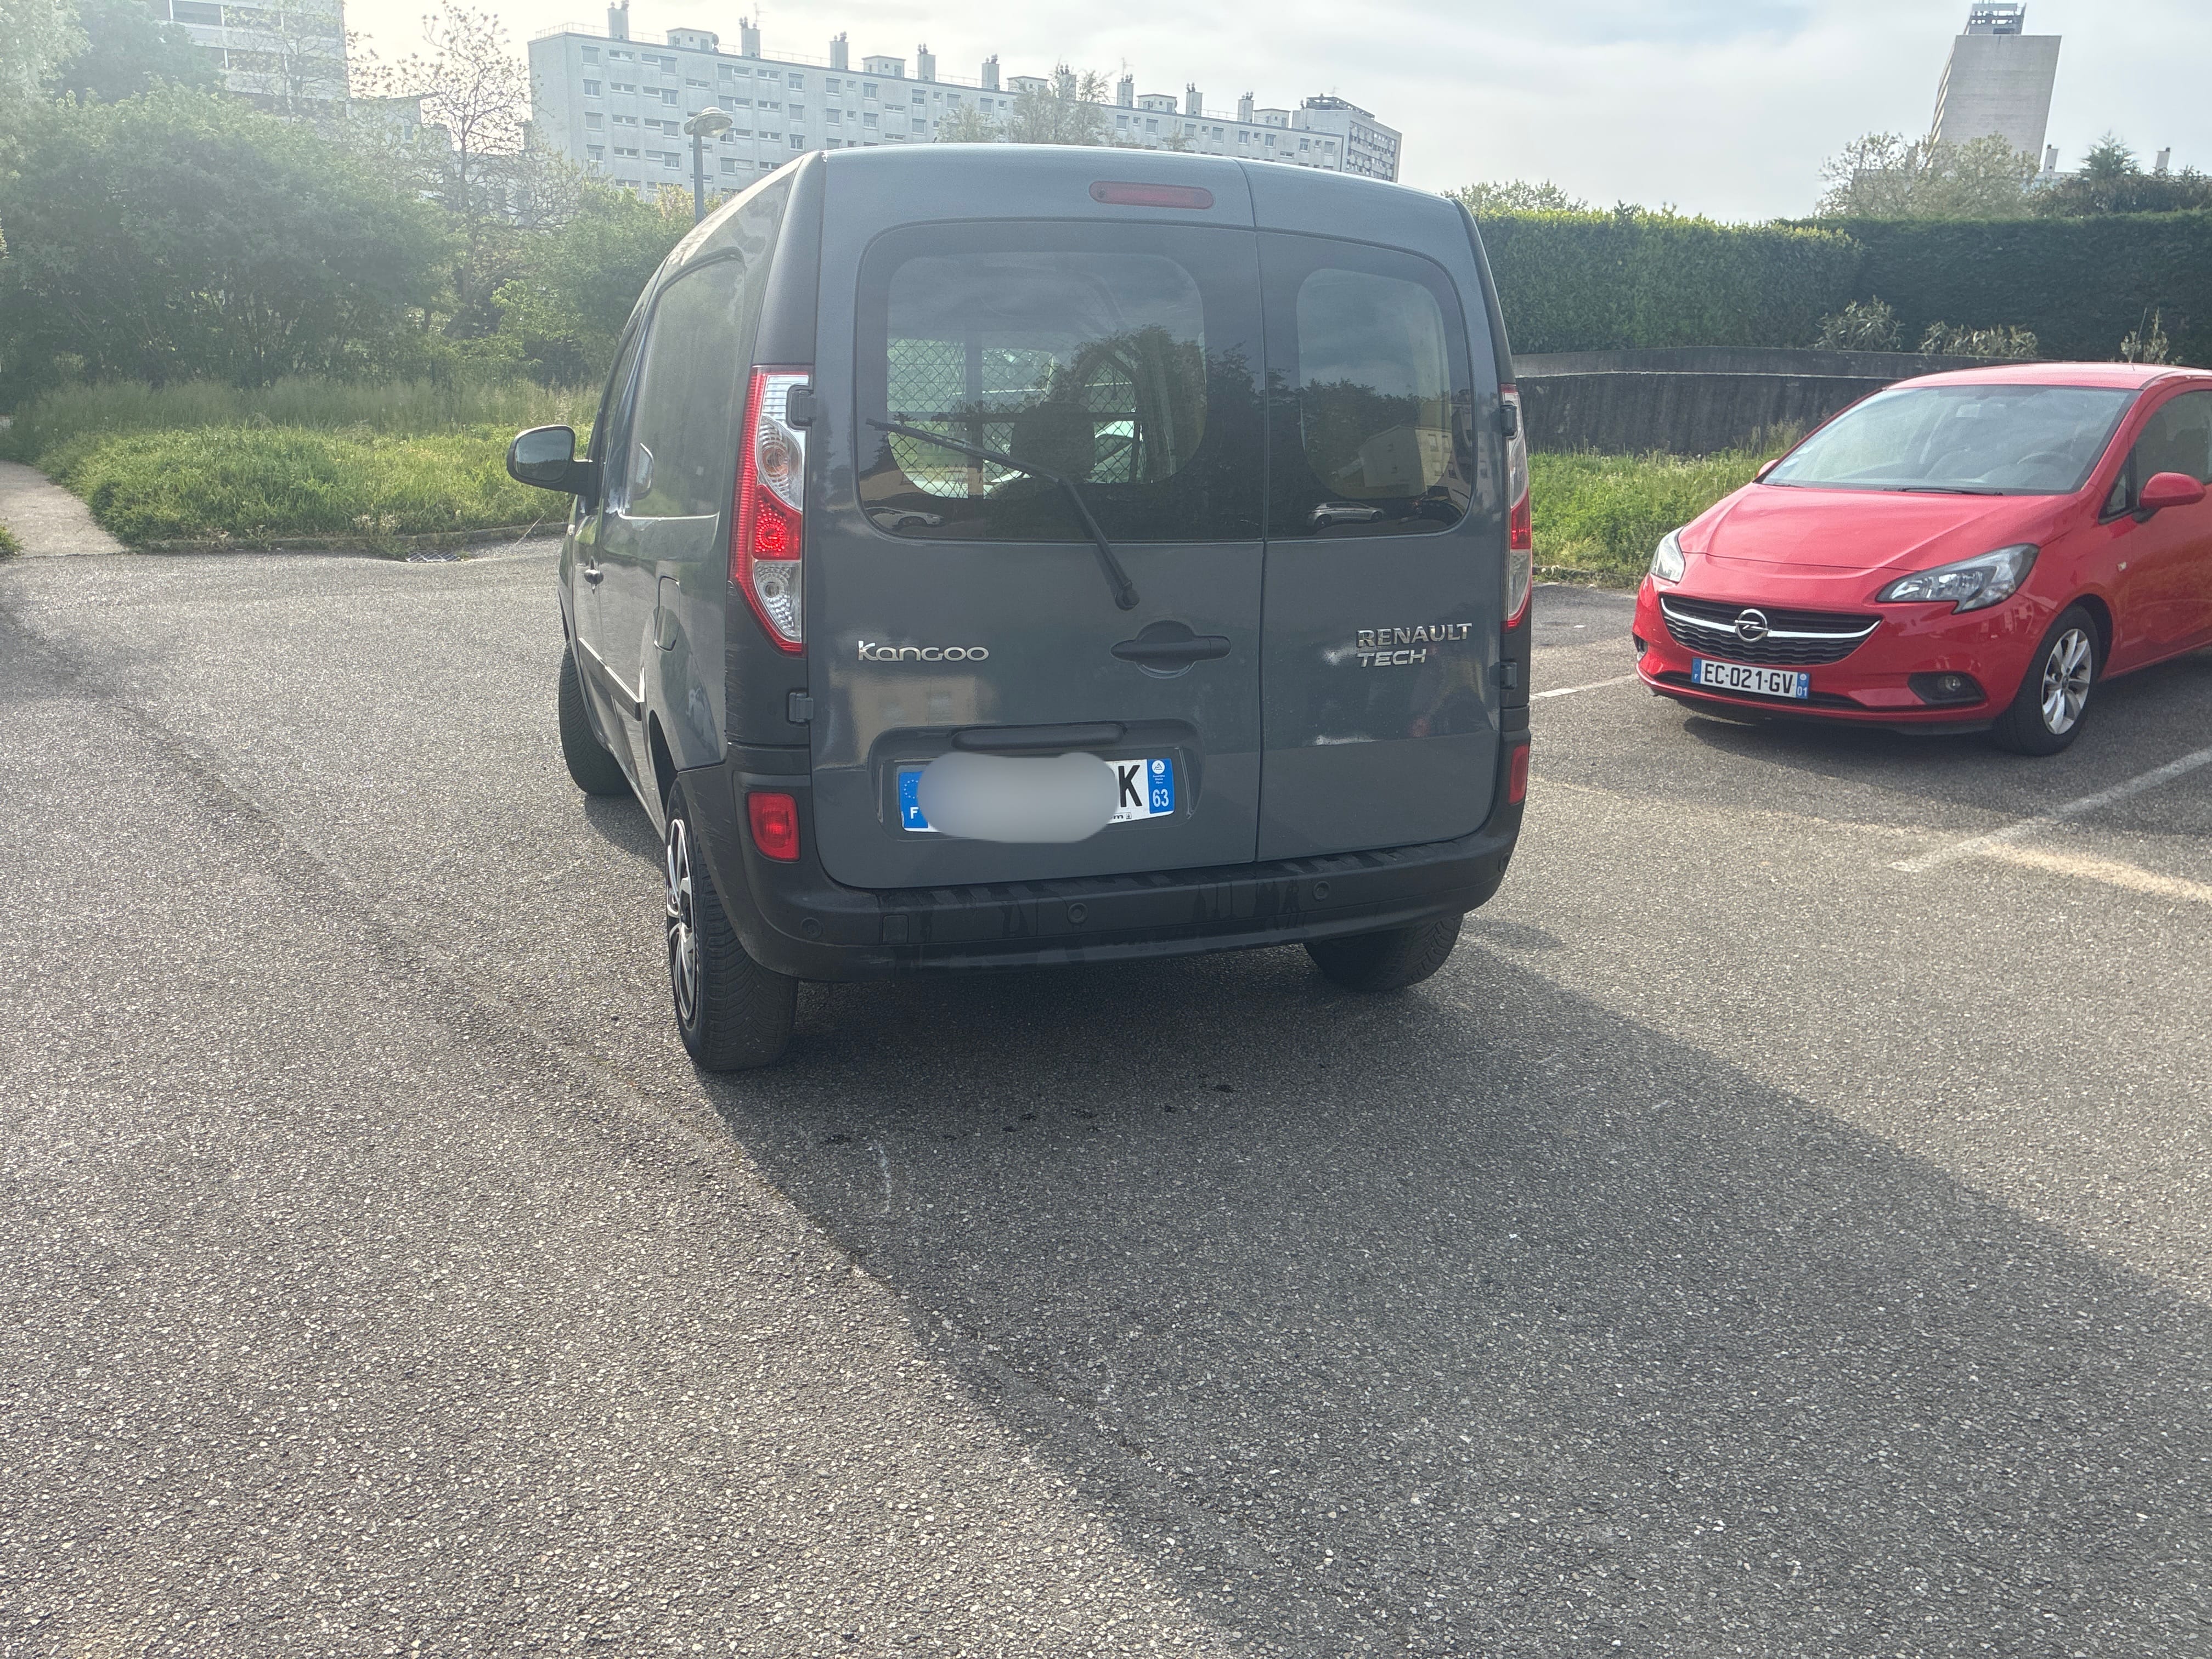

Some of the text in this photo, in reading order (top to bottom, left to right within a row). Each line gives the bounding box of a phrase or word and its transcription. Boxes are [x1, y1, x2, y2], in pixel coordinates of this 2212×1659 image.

[1356, 622, 1472, 647] RENAULT
[857, 640, 989, 662] Kangoo
[1356, 648, 1427, 668] TECH
[1704, 663, 1793, 694] EC-021-GV
[1797, 686, 1808, 697] 01
[1152, 788, 1170, 808] 63
[910, 806, 919, 820] F
